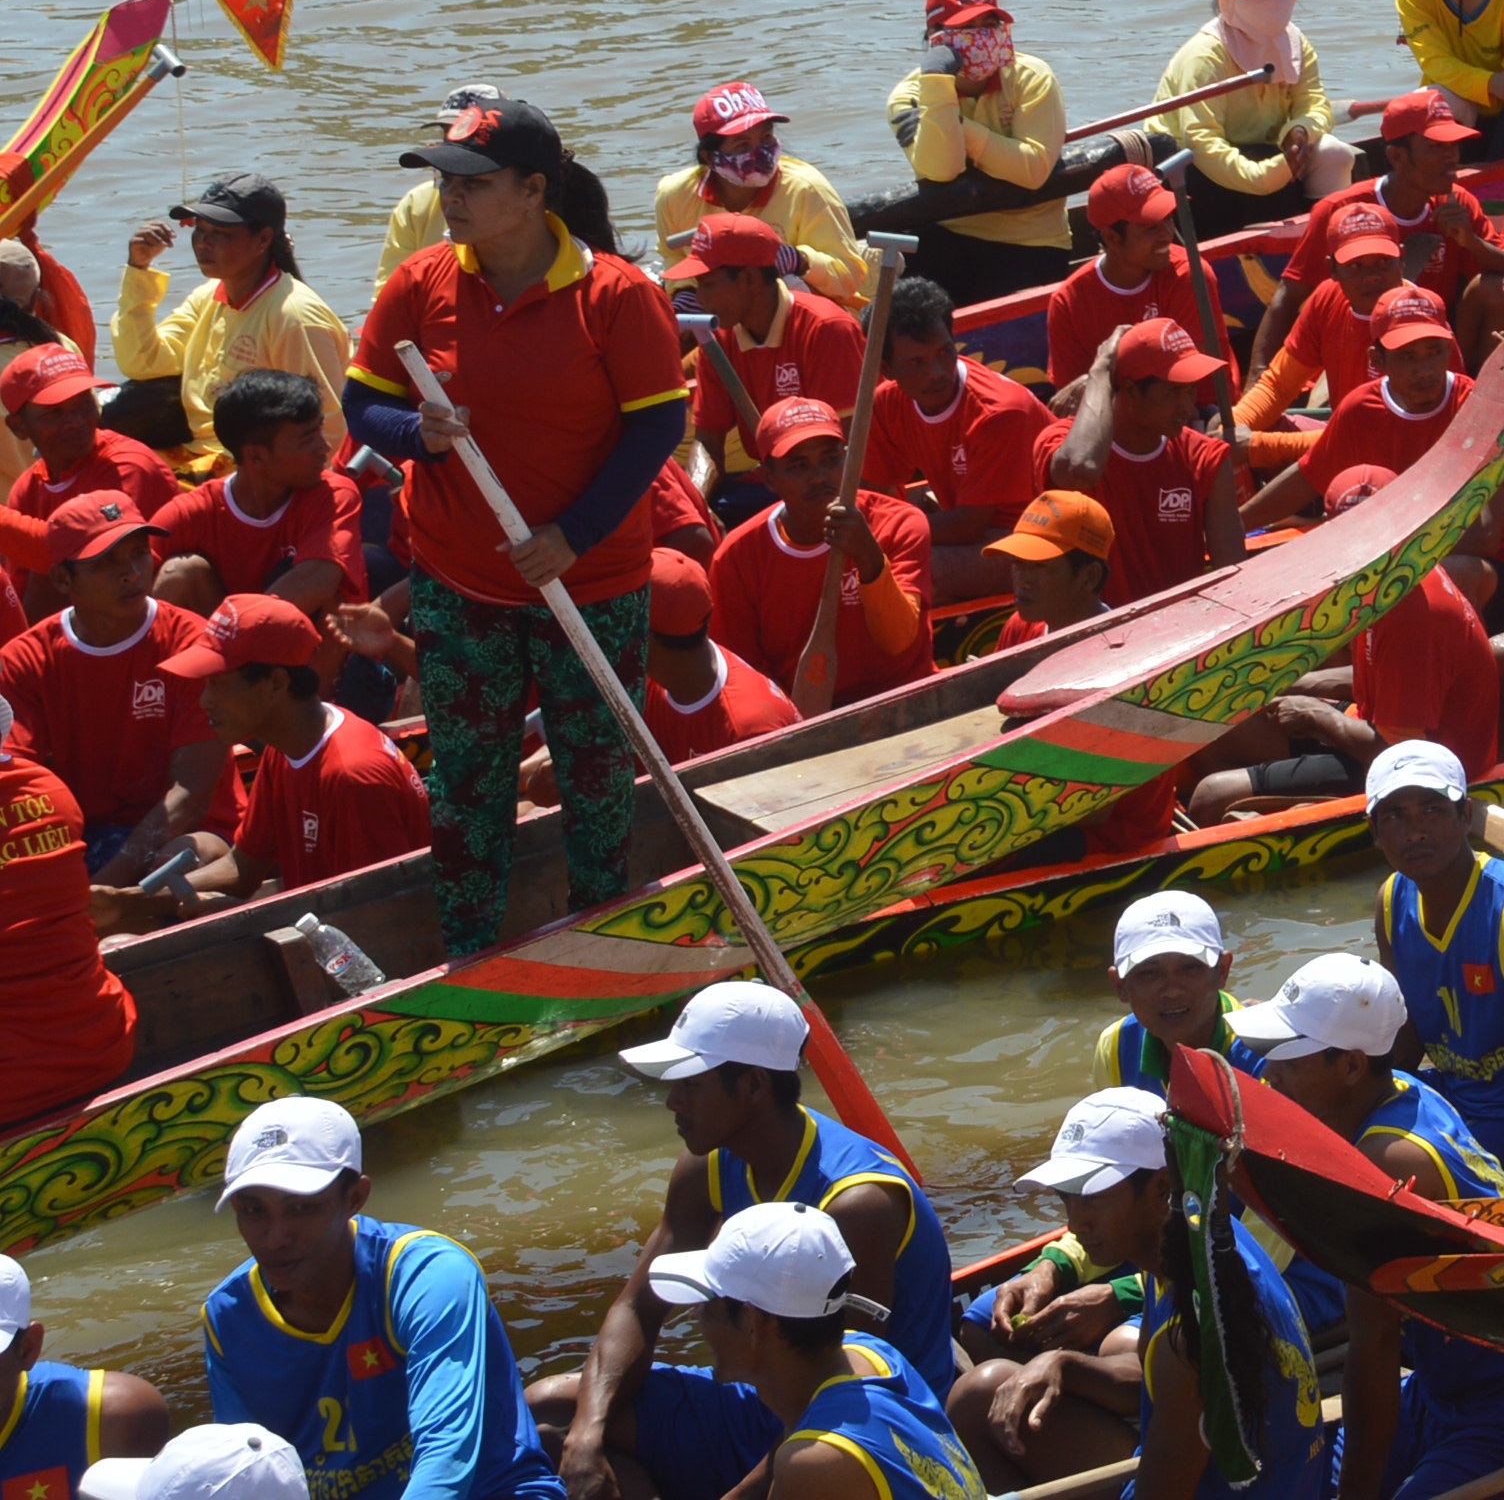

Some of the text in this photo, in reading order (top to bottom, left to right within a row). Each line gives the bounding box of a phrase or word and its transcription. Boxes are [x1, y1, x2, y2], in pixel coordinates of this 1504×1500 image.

[1161, 492, 1190, 509] ADP
[804, 653, 827, 686] 8
[11, 793, 55, 824] TỘC
[22, 824, 72, 857] LIÊU
